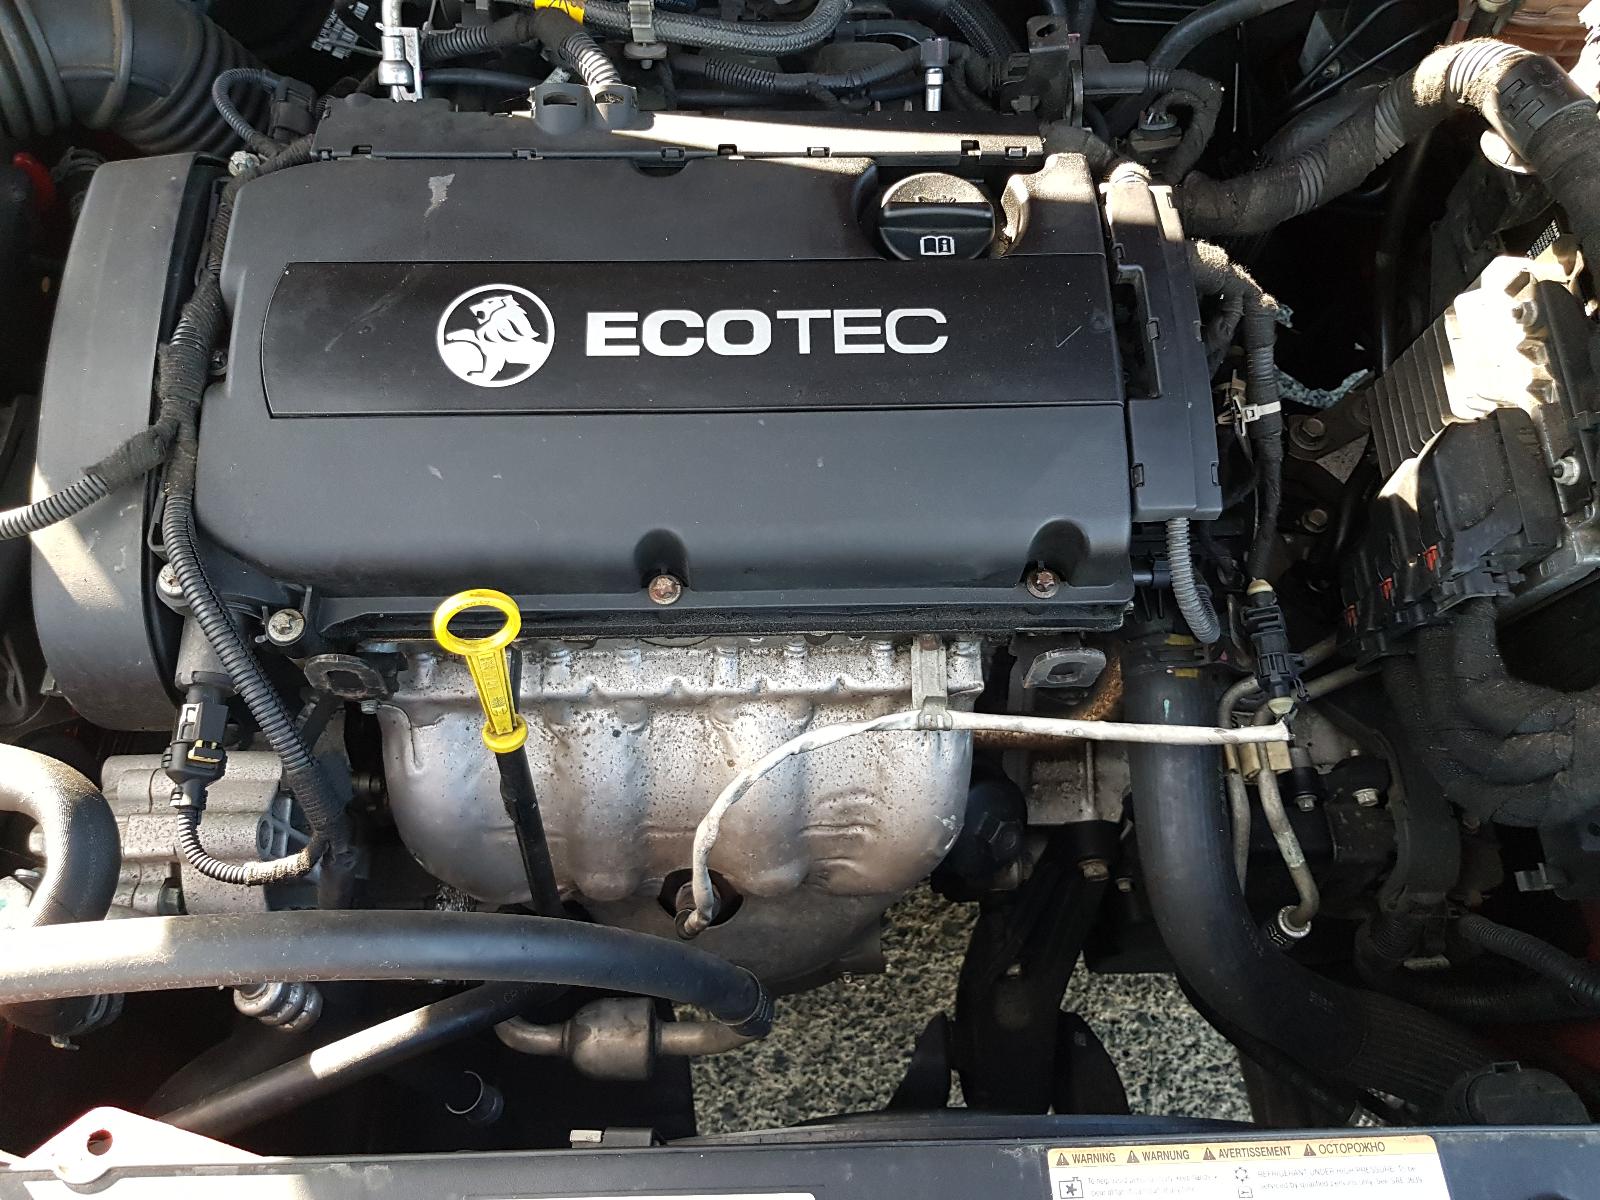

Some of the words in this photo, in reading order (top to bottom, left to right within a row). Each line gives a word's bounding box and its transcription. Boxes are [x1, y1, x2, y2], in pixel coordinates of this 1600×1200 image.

[585, 308, 949, 357] ECOTEC
[1071, 1149, 1116, 1164] WARNING
[1141, 1147, 1190, 1162] WARNUNG
[1218, 1145, 1292, 1160] AVERTISSEMENT
[1318, 1141, 1386, 1155] ОСТОРОЖНО
